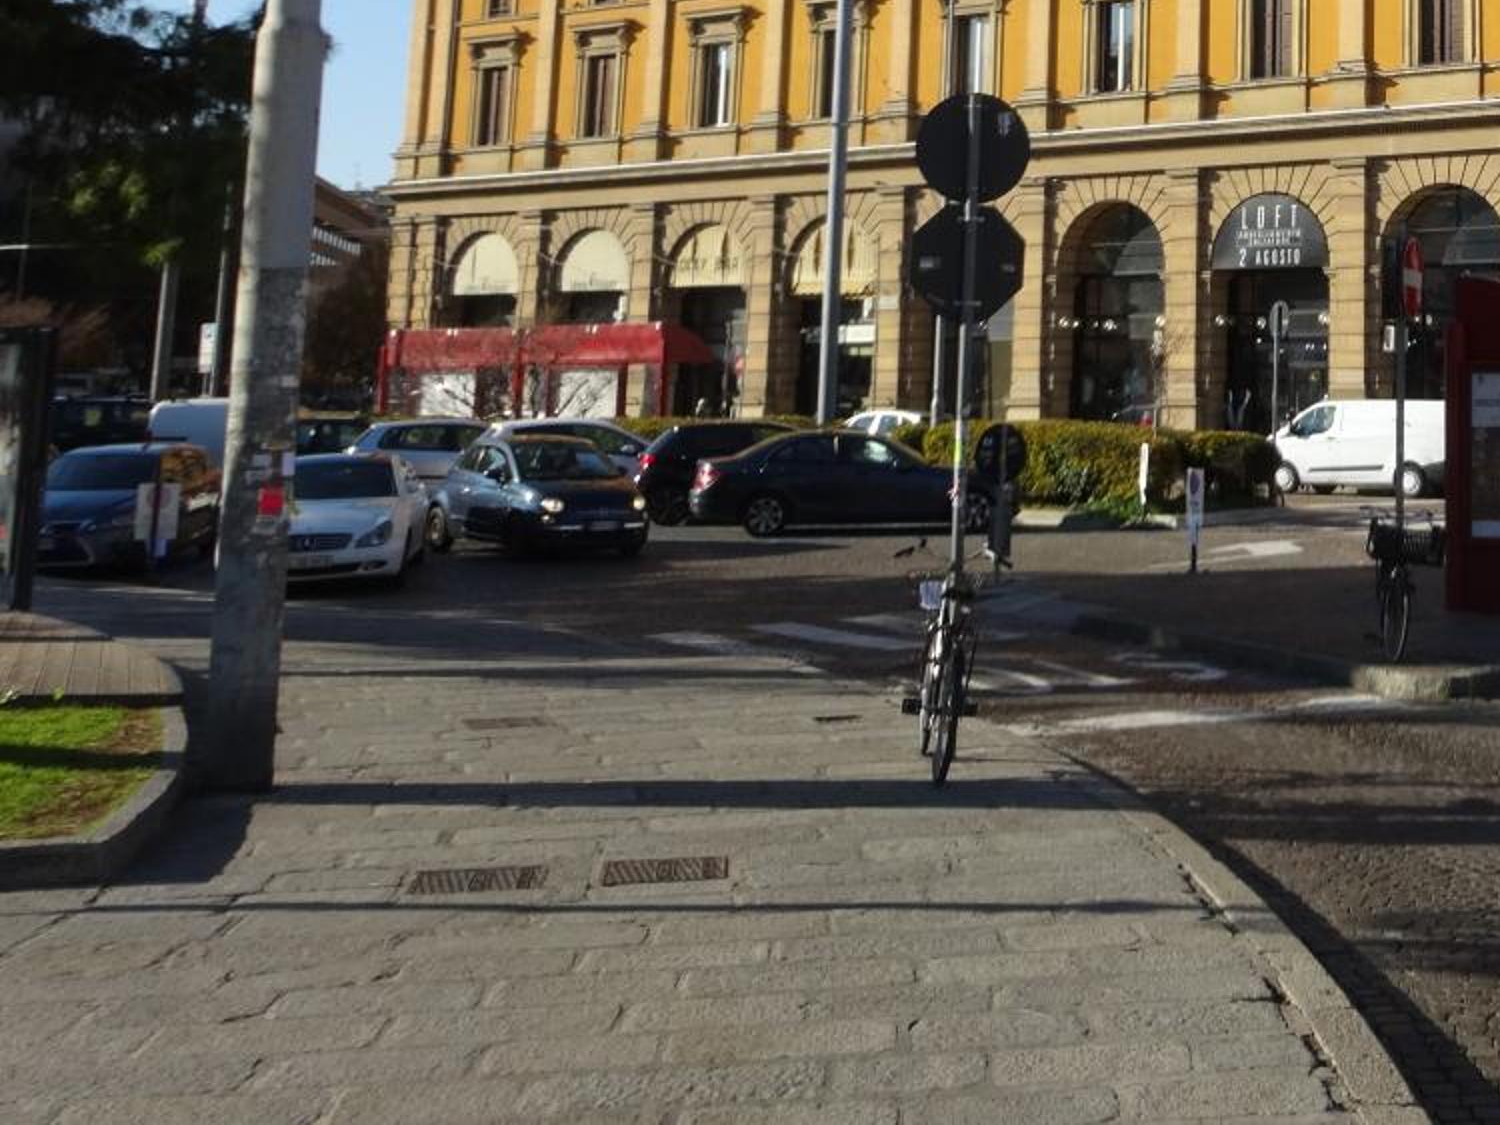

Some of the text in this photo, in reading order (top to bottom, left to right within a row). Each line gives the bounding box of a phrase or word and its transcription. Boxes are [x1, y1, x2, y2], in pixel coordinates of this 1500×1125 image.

[1241, 204, 1298, 230] LOFT
[1239, 248, 1301, 267] 2 AGOSTO
